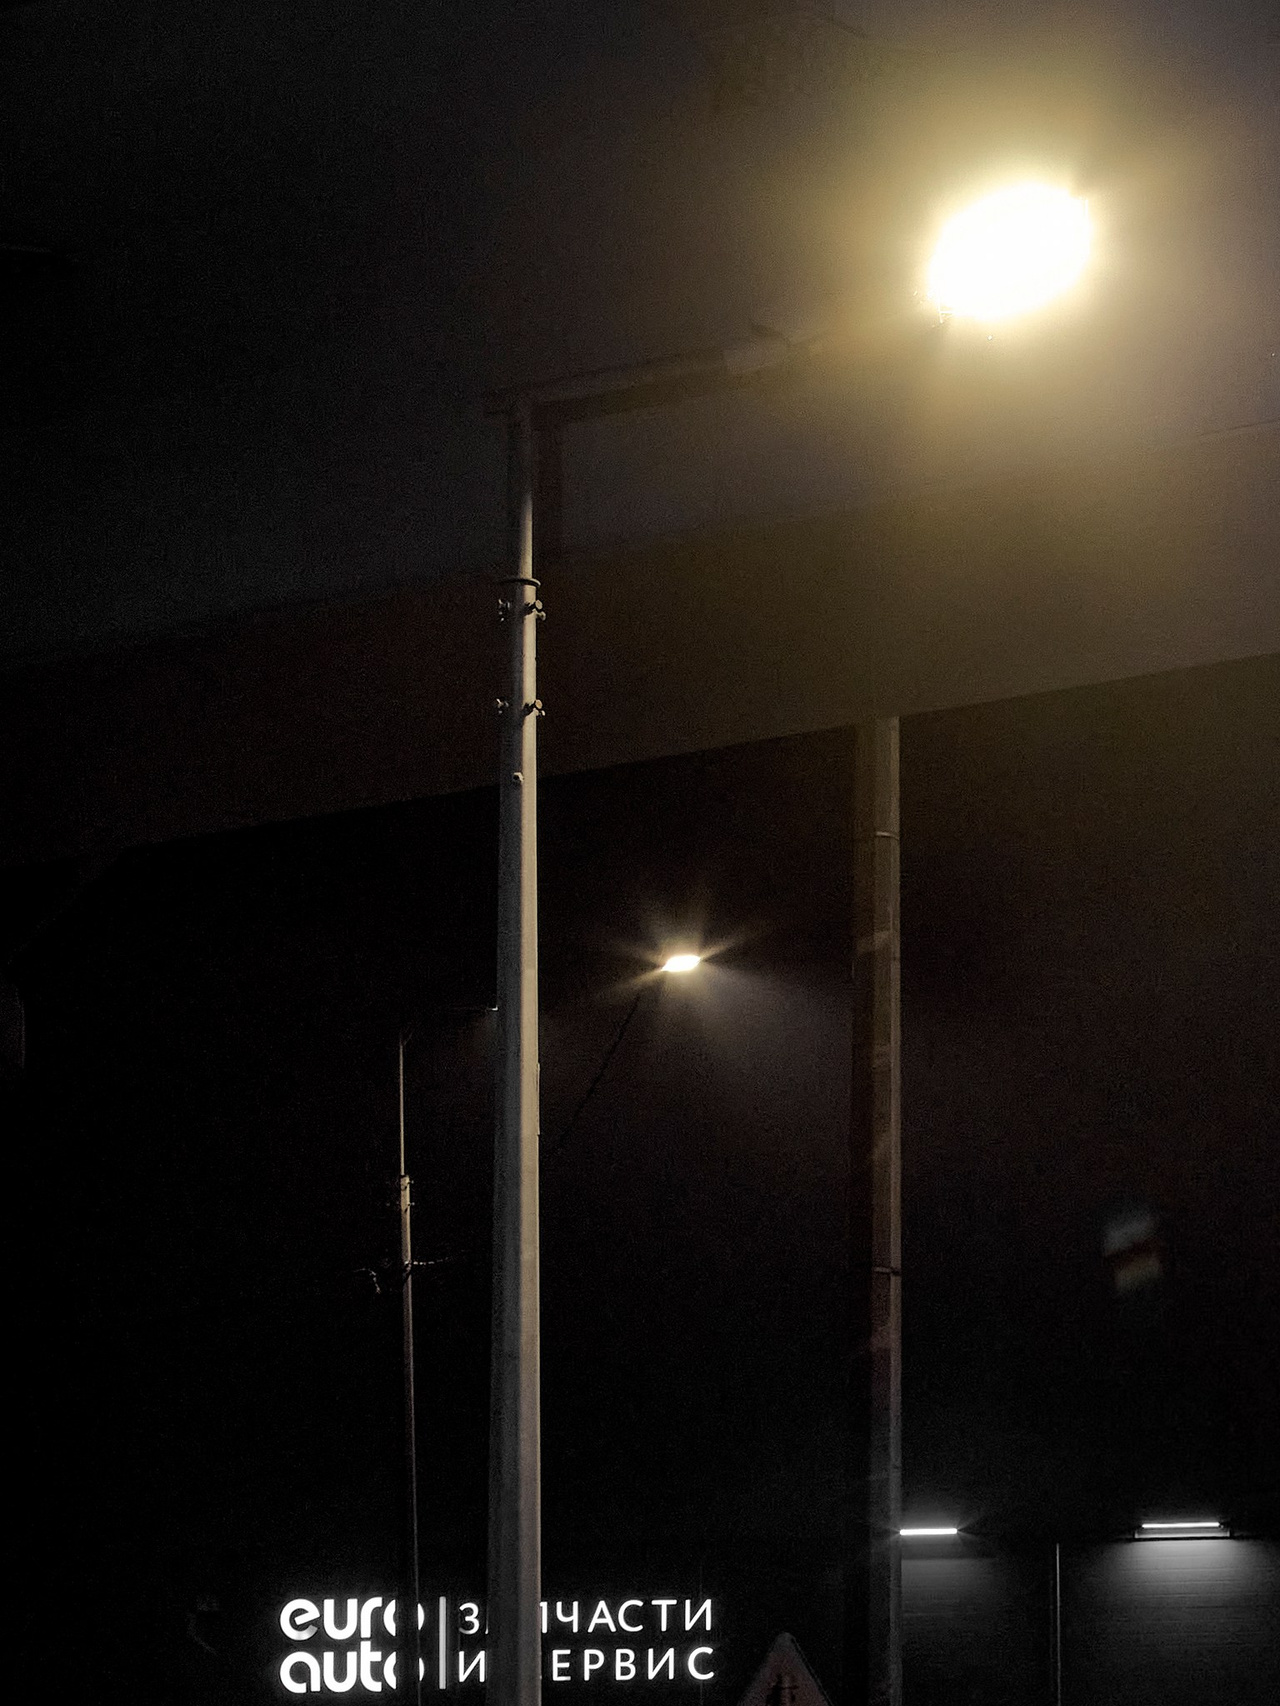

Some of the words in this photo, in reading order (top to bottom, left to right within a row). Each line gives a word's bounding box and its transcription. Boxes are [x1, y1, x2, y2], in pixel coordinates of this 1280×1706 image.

[459, 1599, 712, 1635] ЗЧАСТИ
[458, 1651, 486, 1682] И
[552, 1647, 715, 1681] ЕРВИС
